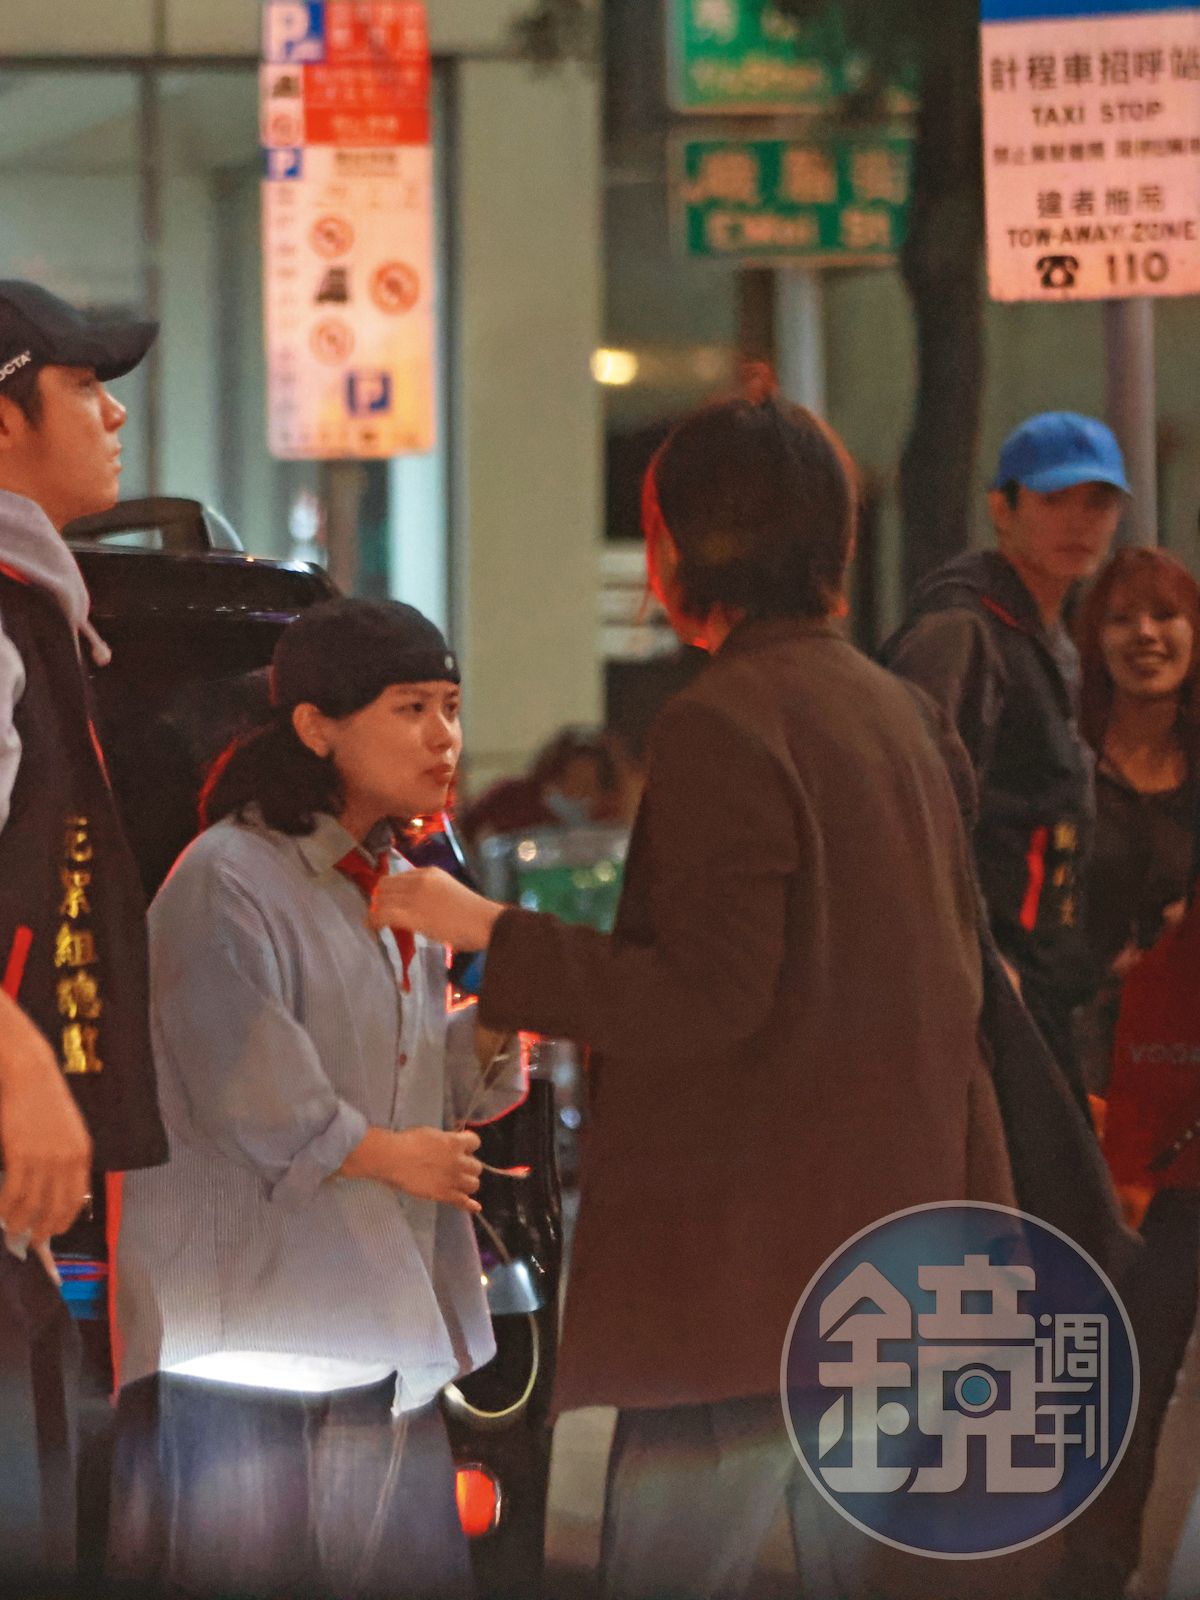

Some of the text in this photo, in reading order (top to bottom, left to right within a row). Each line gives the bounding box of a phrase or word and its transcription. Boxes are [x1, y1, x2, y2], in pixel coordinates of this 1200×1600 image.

[1032, 101, 1163, 126] TAXI STOP
[1131, 221, 1196, 243] ZONE
[1107, 252, 1169, 284] 110
